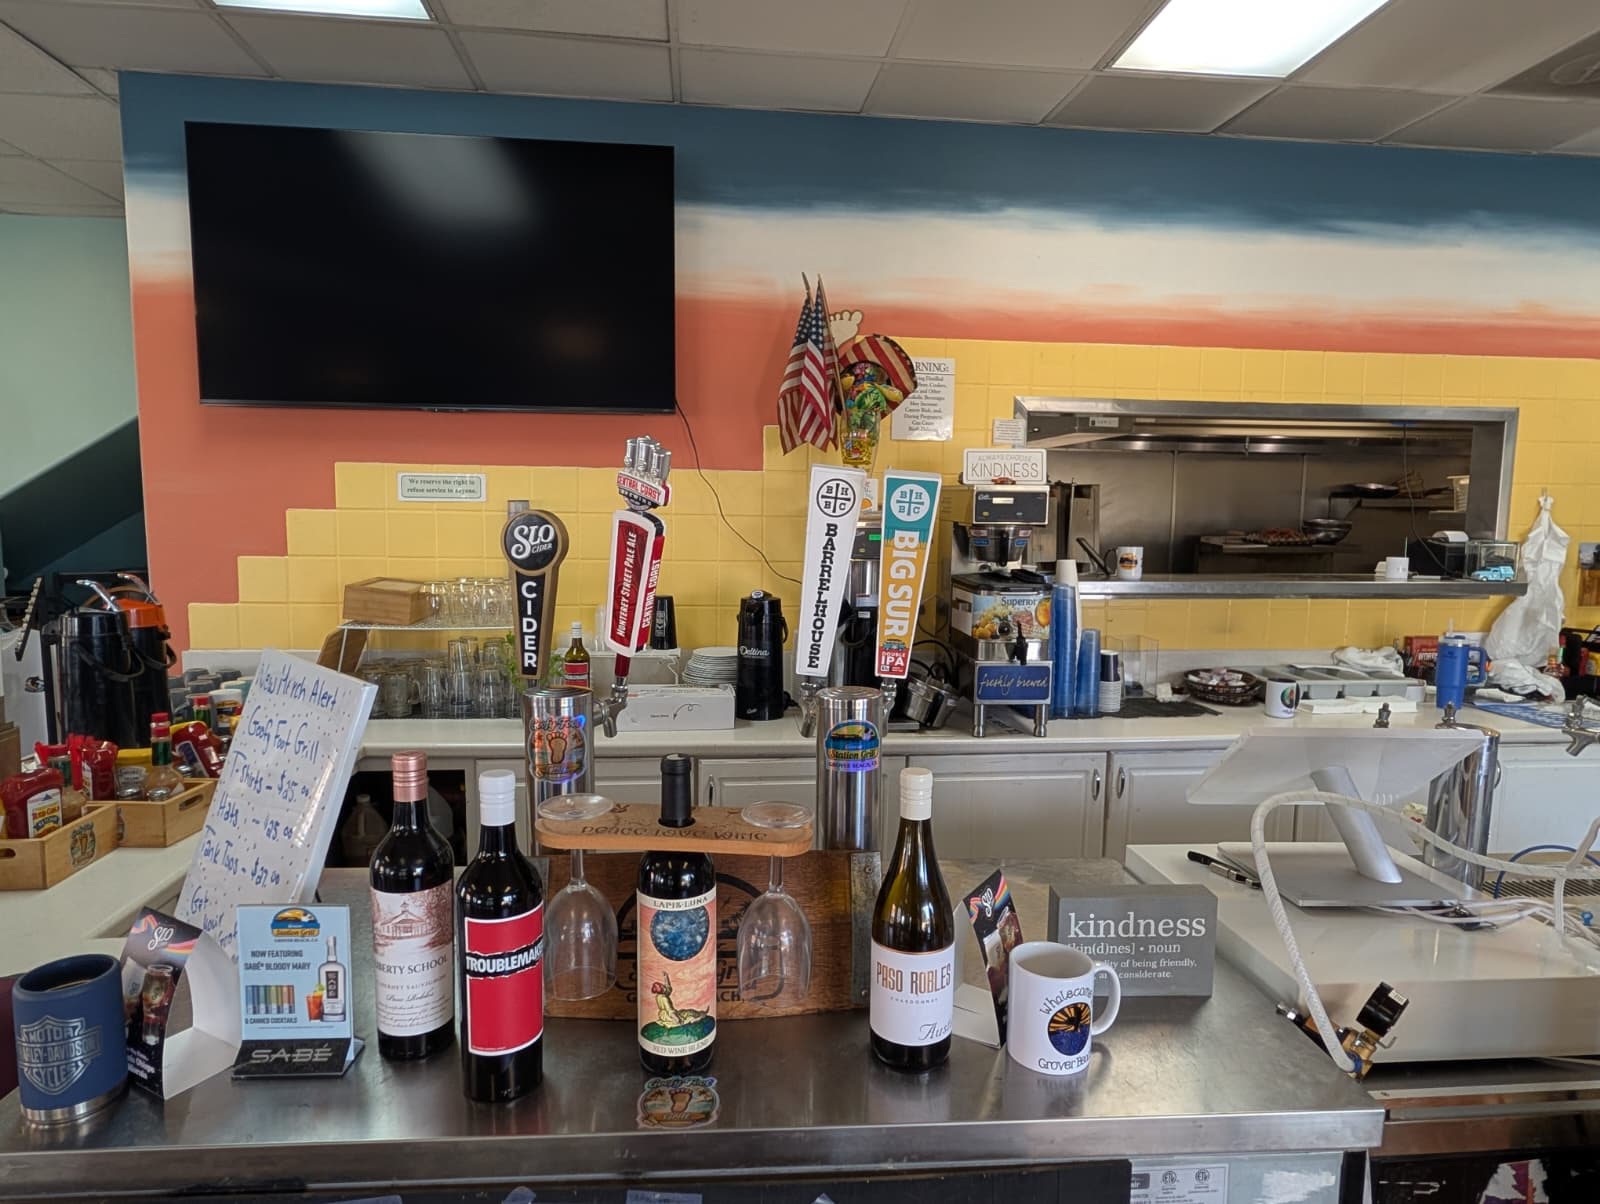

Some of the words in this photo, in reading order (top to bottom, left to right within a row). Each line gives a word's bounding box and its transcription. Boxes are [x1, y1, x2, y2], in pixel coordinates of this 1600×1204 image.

[915, 362, 950, 372] RNING:
[972, 462, 1038, 478] KINDNESS
[640, 483, 660, 502] COAST
[511, 524, 555, 559] SLO
[890, 530, 921, 580] BIG
[808, 523, 838, 668] BARRELHOUSE
[1001, 596, 1036, 608] Superior
[884, 584, 914, 637] SUR
[521, 581, 538, 668] CIDER
[882, 656, 904, 666] IPA
[310, 679, 338, 711] Alert
[978, 673, 1014, 696] freshly
[1016, 674, 1050, 689] brewed
[294, 722, 320, 764] Grill
[581, 826, 648, 837] peace
[654, 828, 708, 838] love
[714, 830, 768, 842] wine
[1068, 912, 1206, 938] kindness
[466, 938, 544, 973] TROUBLEMAKE
[1148, 944, 1181, 953] noun
[265, 962, 291, 970] BLOODY
[292, 962, 311, 970] MARY
[407, 954, 447, 975] SCHOOL
[1118, 970, 1174, 978] considerate.
[1120, 960, 1130, 968] of
[1132, 958, 1158, 970] being
[1160, 958, 1198, 970] friendly,
[876, 962, 904, 992] PASO
[910, 962, 951, 997] ROBLES
[28, 1024, 73, 1042] MOTOR
[250, 1042, 333, 1064] SABÉ
[1038, 1056, 1076, 1072] Grover
